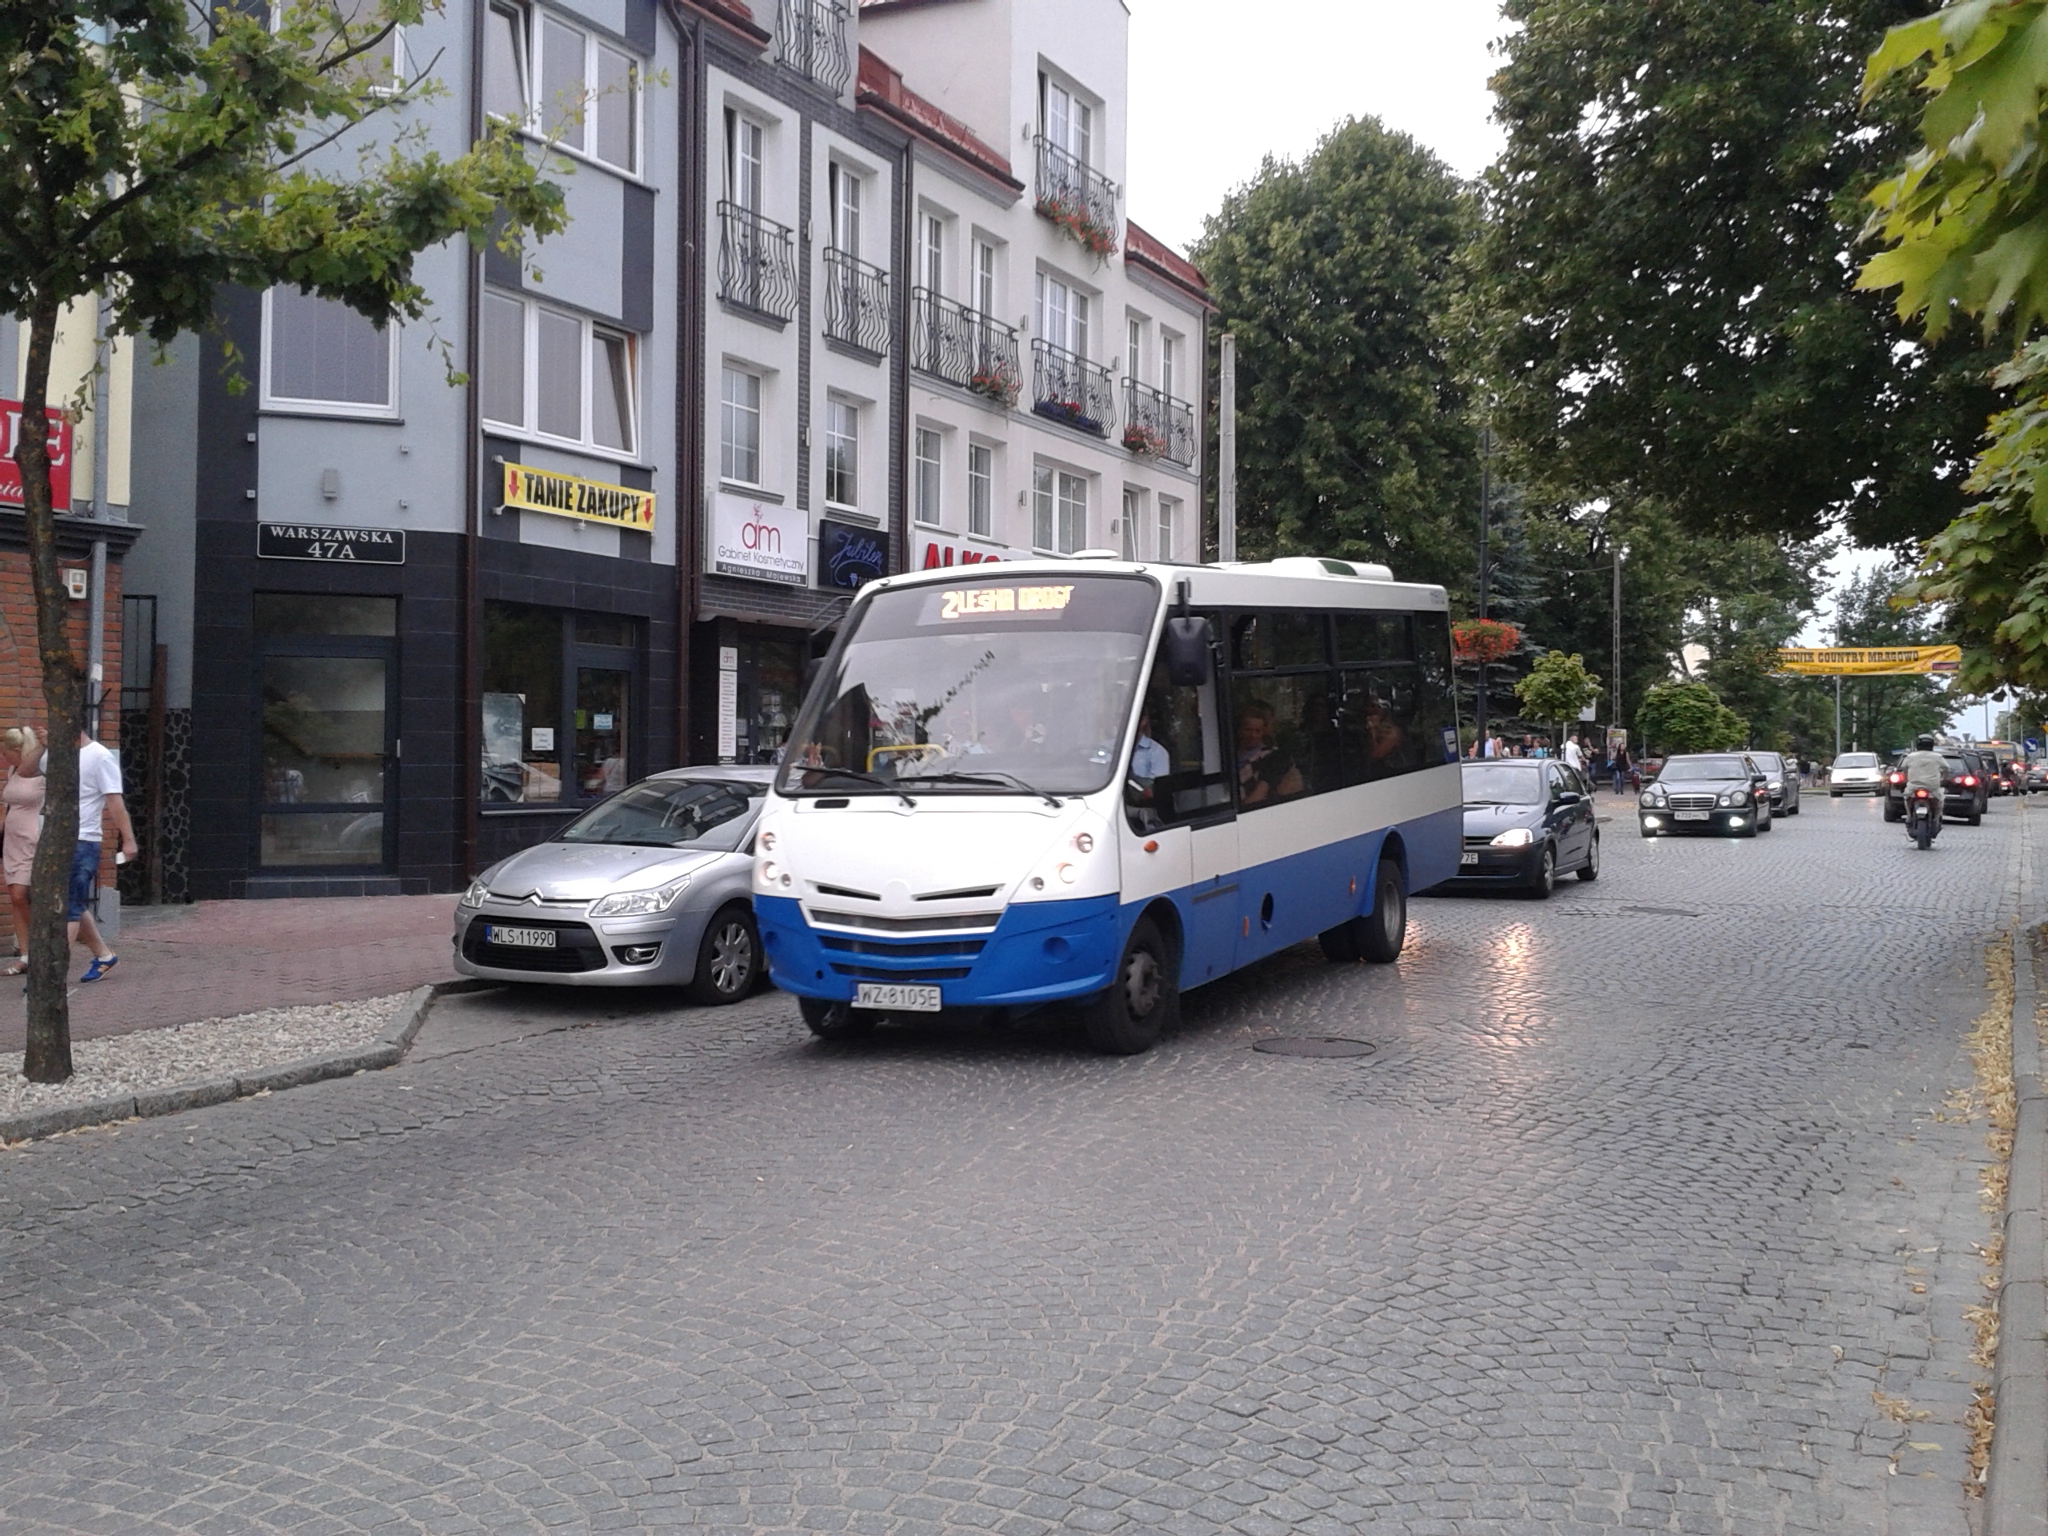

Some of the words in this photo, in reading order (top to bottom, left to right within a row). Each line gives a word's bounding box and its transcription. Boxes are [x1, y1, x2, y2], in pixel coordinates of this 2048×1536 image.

[524, 473, 574, 512] TANIE
[577, 483, 640, 522] ZAKUPY
[270, 526, 393, 544] WARSZAWSKA
[307, 542, 356, 559] 47A
[718, 545, 752, 562] Gabinet
[753, 552, 805, 572] Kosmetyczny
[830, 531, 883, 569] Jubiler
[721, 563, 760, 577] Agnieszka
[766, 571, 801, 583] Majewska
[941, 591, 959, 618] 2
[1817, 651, 1865, 663] COUNTRY
[492, 928, 515, 944] WLS
[519, 930, 555, 946] 11990
[861, 985, 884, 1004] WZ
[888, 987, 938, 1007] 8105E
